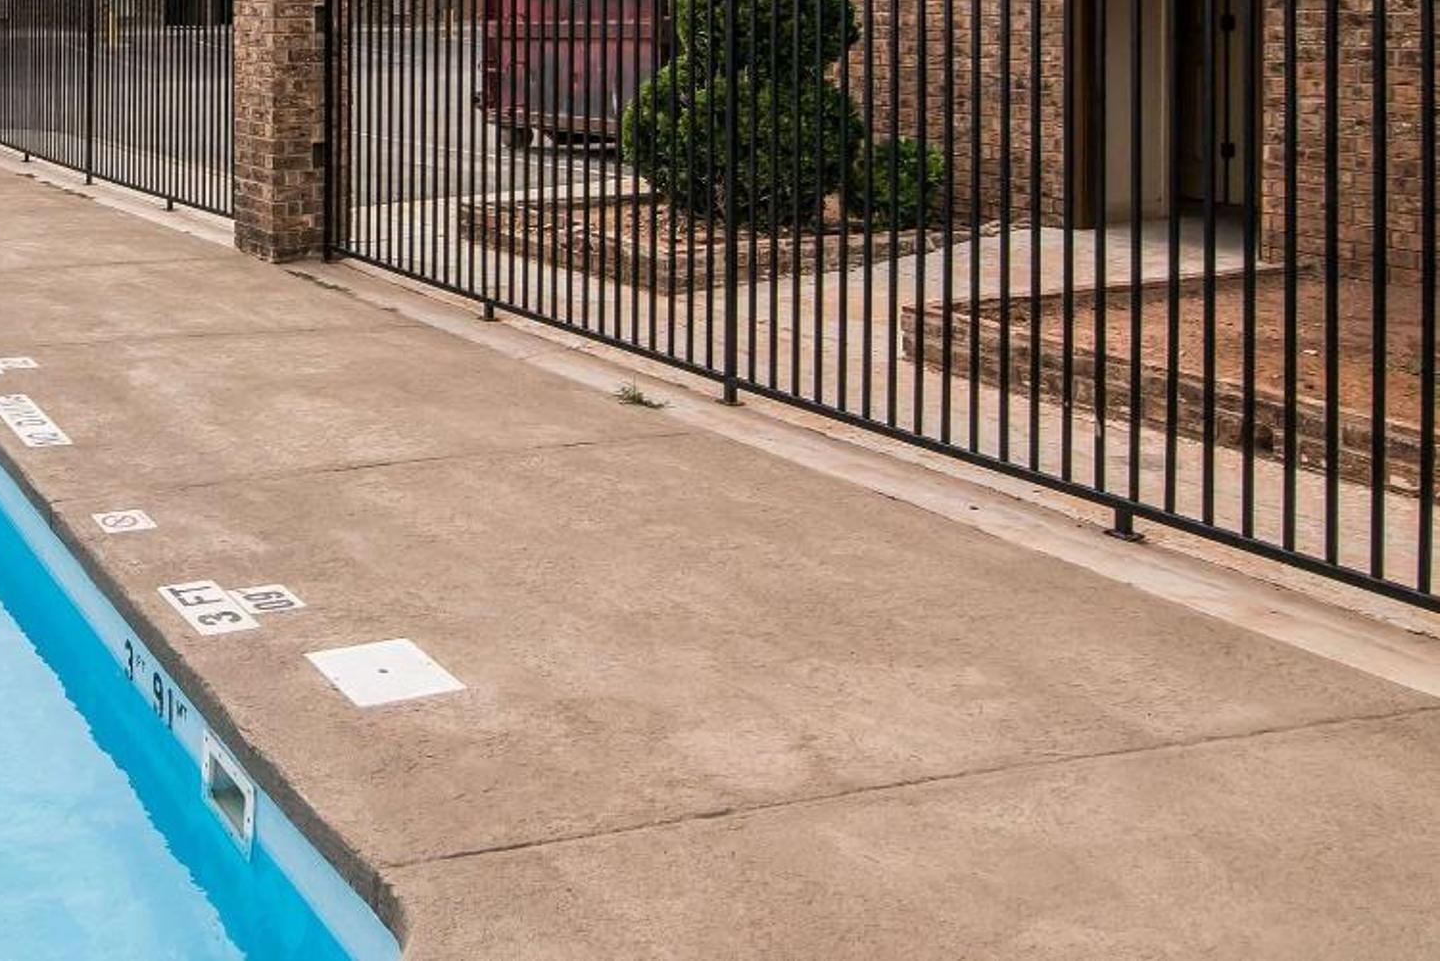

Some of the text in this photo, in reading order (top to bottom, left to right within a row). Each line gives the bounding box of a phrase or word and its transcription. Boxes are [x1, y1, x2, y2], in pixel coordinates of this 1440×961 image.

[166, 585, 243, 626] 3 FT
[124, 638, 134, 682] 3
[153, 671, 173, 731] 91
